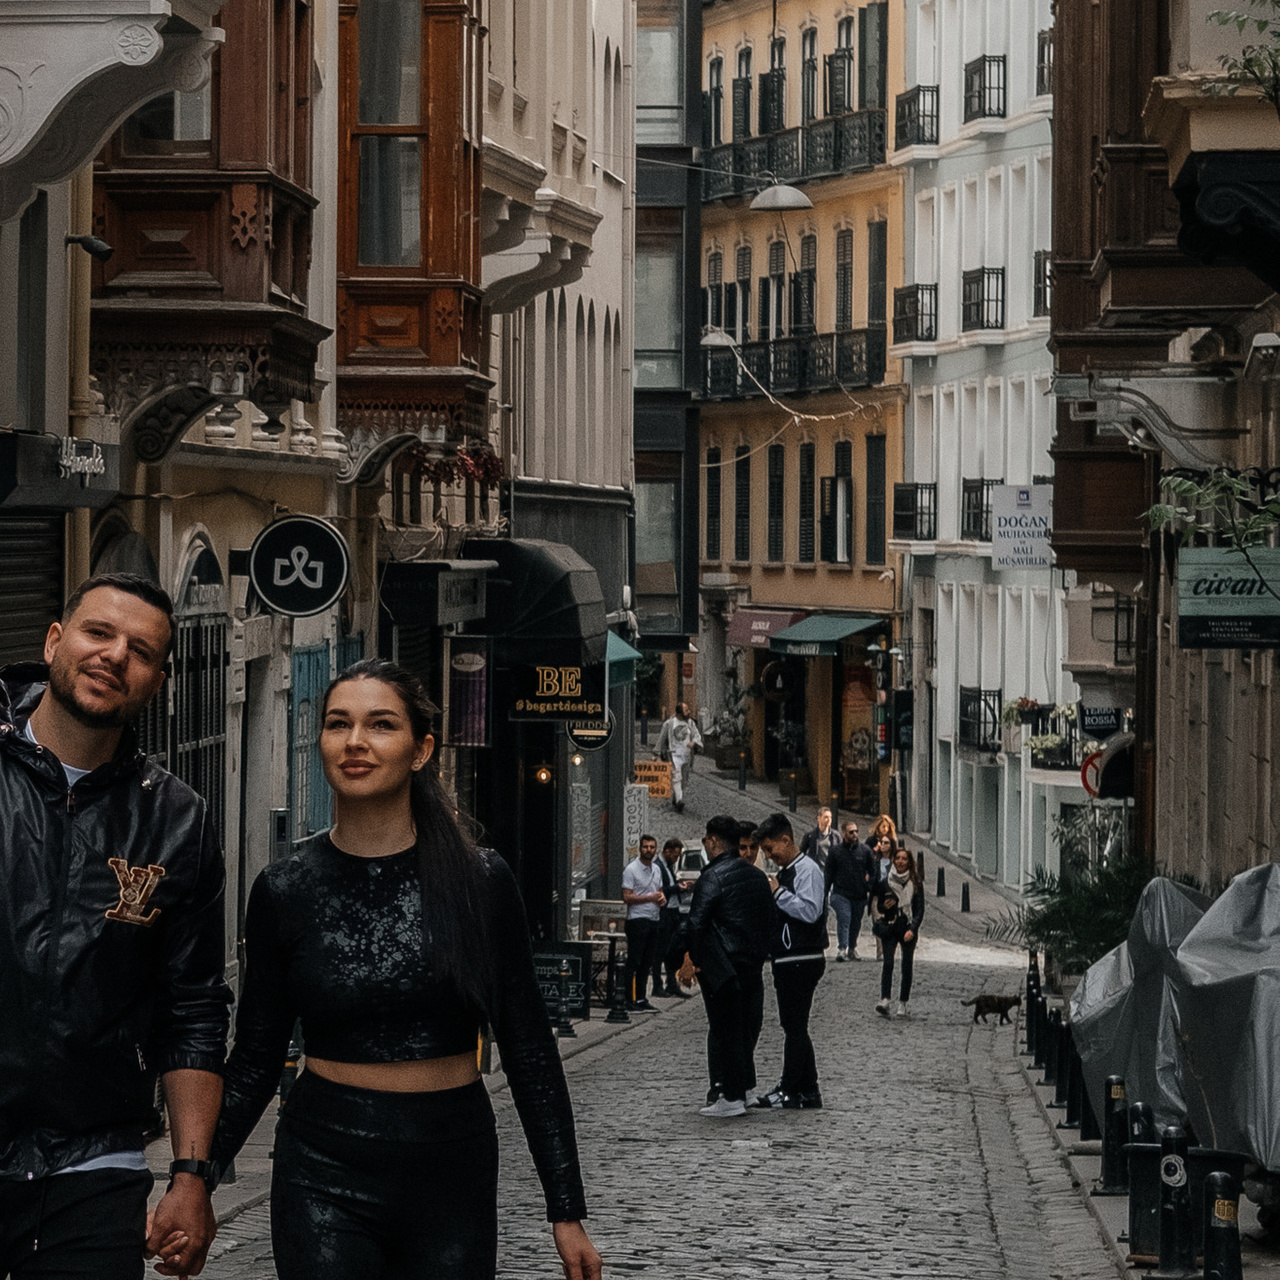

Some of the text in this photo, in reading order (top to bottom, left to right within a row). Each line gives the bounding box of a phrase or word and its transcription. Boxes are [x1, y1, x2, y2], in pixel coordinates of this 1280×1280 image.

[997, 513, 1048, 528] DOĞAN
[1192, 573, 1267, 596] civan
[535, 666, 582, 697] BE
[1084, 715, 1117, 726] ROSSA
[105, 857, 166, 927] LV
